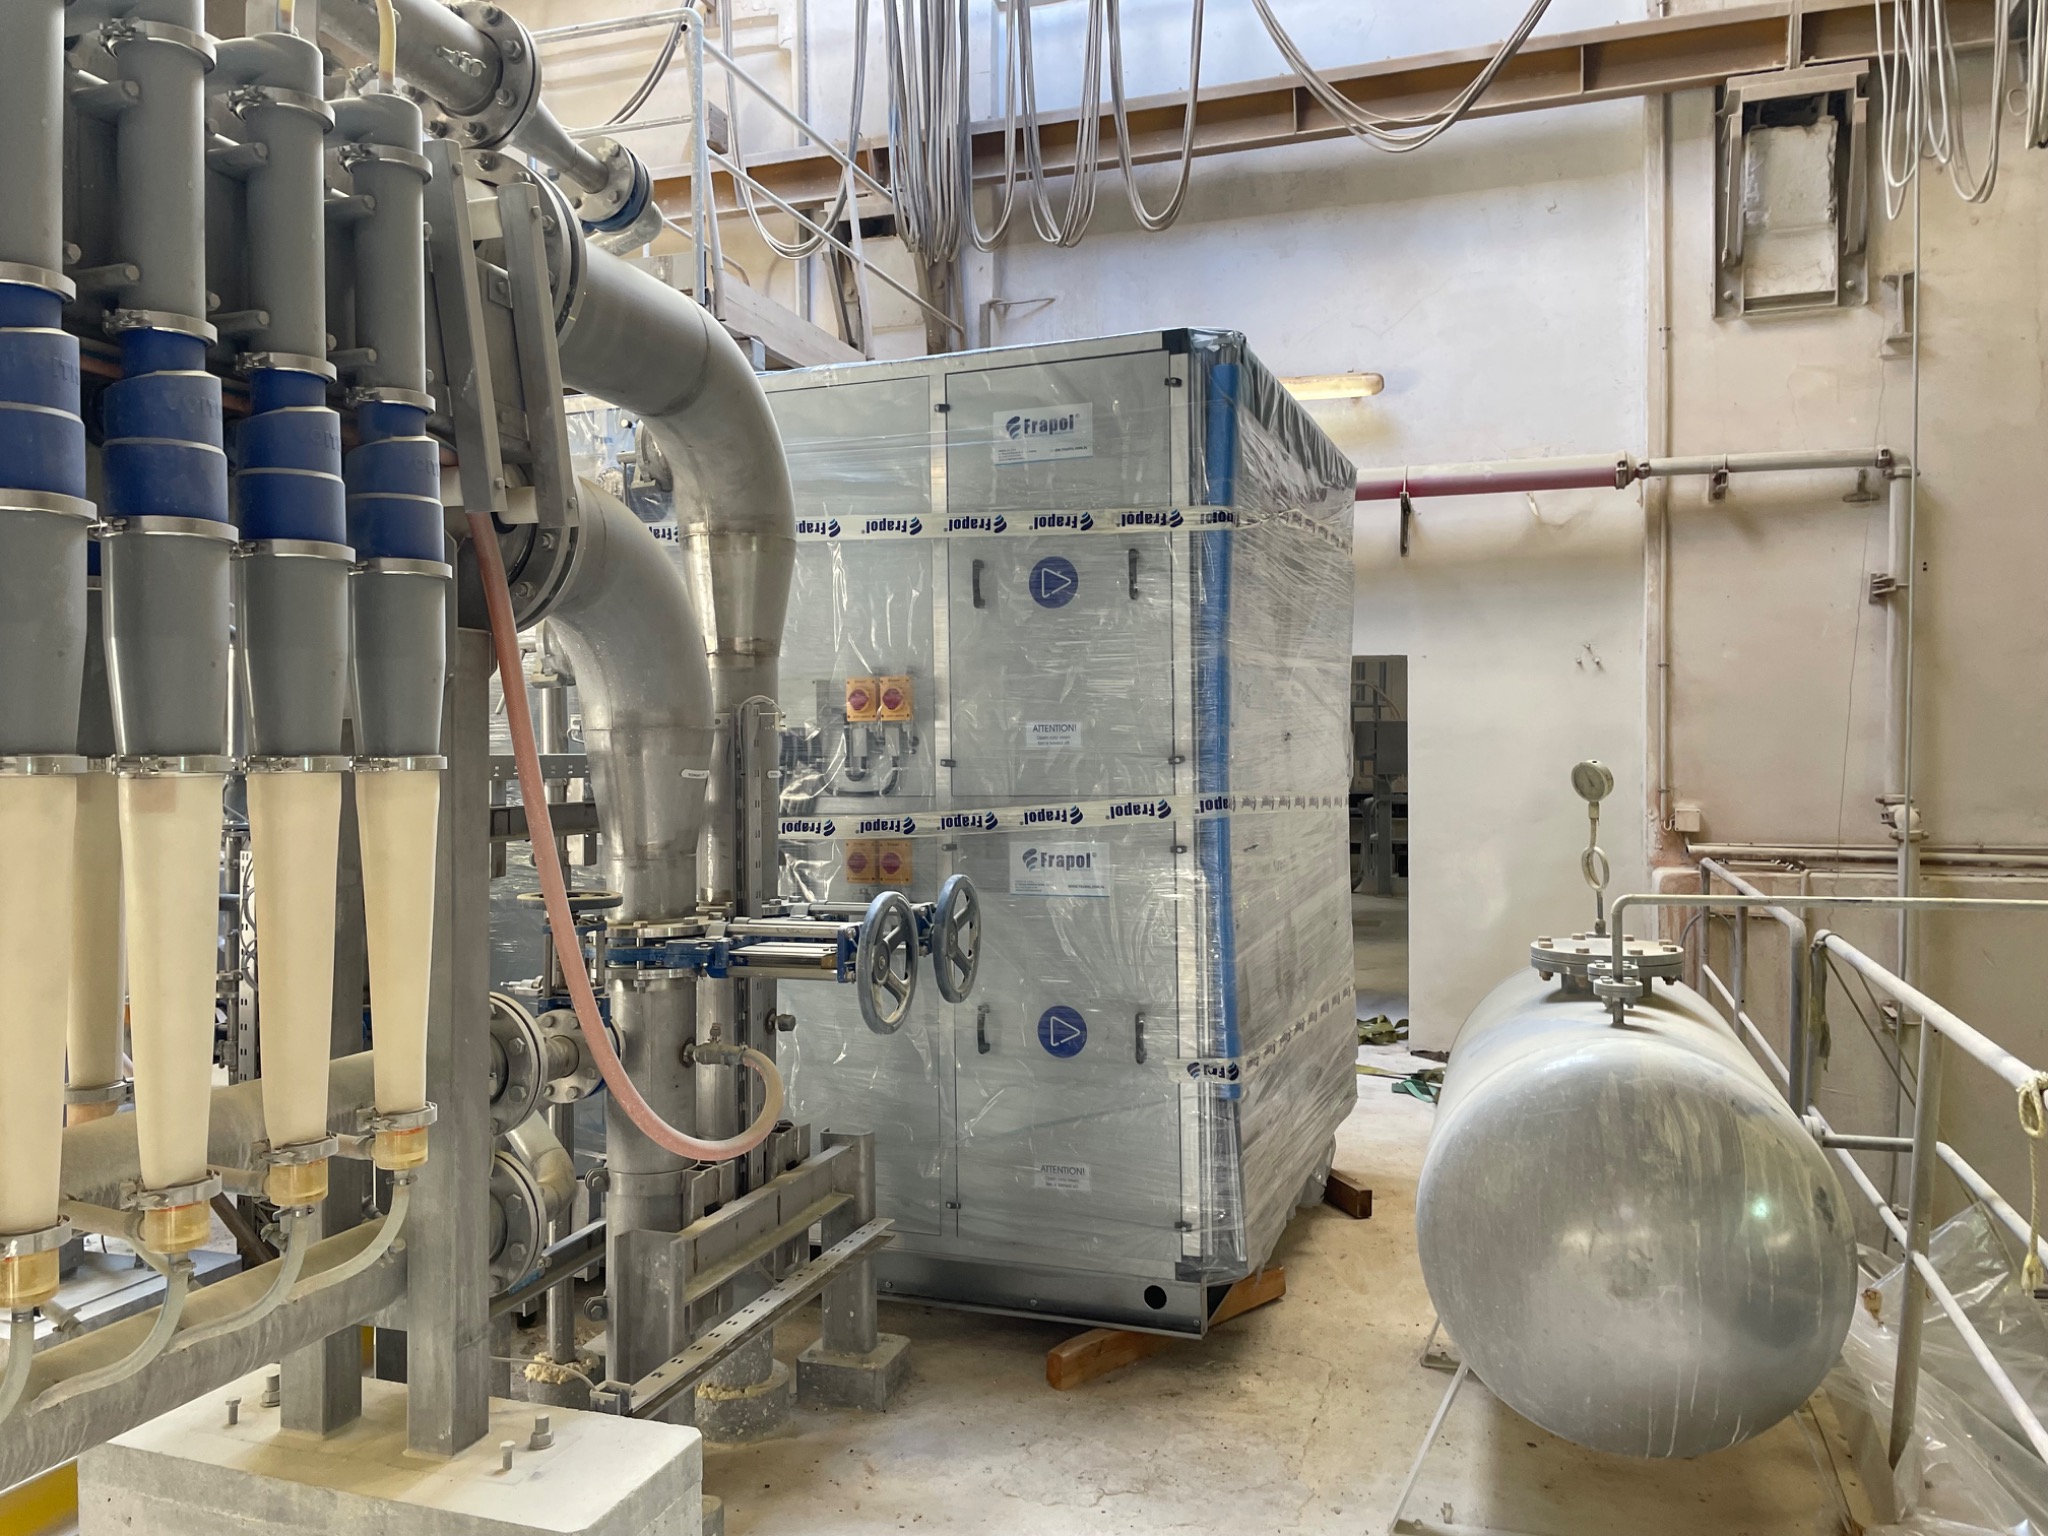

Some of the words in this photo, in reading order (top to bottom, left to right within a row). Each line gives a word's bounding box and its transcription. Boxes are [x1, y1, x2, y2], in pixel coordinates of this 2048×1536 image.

[1024, 414, 1074, 435] Frapol
[866, 518, 907, 534] Frapol
[949, 516, 991, 532] Frapol
[1034, 513, 1078, 530] Frapol
[1122, 510, 1167, 527] Frapol
[649, 526, 673, 541] Fra
[796, 520, 826, 535] Frap
[1032, 723, 1077, 733] ATTENTION!
[1024, 808, 1067, 825] Frapol
[1111, 802, 1155, 820] Frapol
[782, 820, 821, 835] Frapol
[860, 818, 901, 834] Frapol
[941, 814, 983, 830] Frapol
[1041, 852, 1091, 871] Frapol
[1040, 1164, 1085, 1175] ATTENTION!
